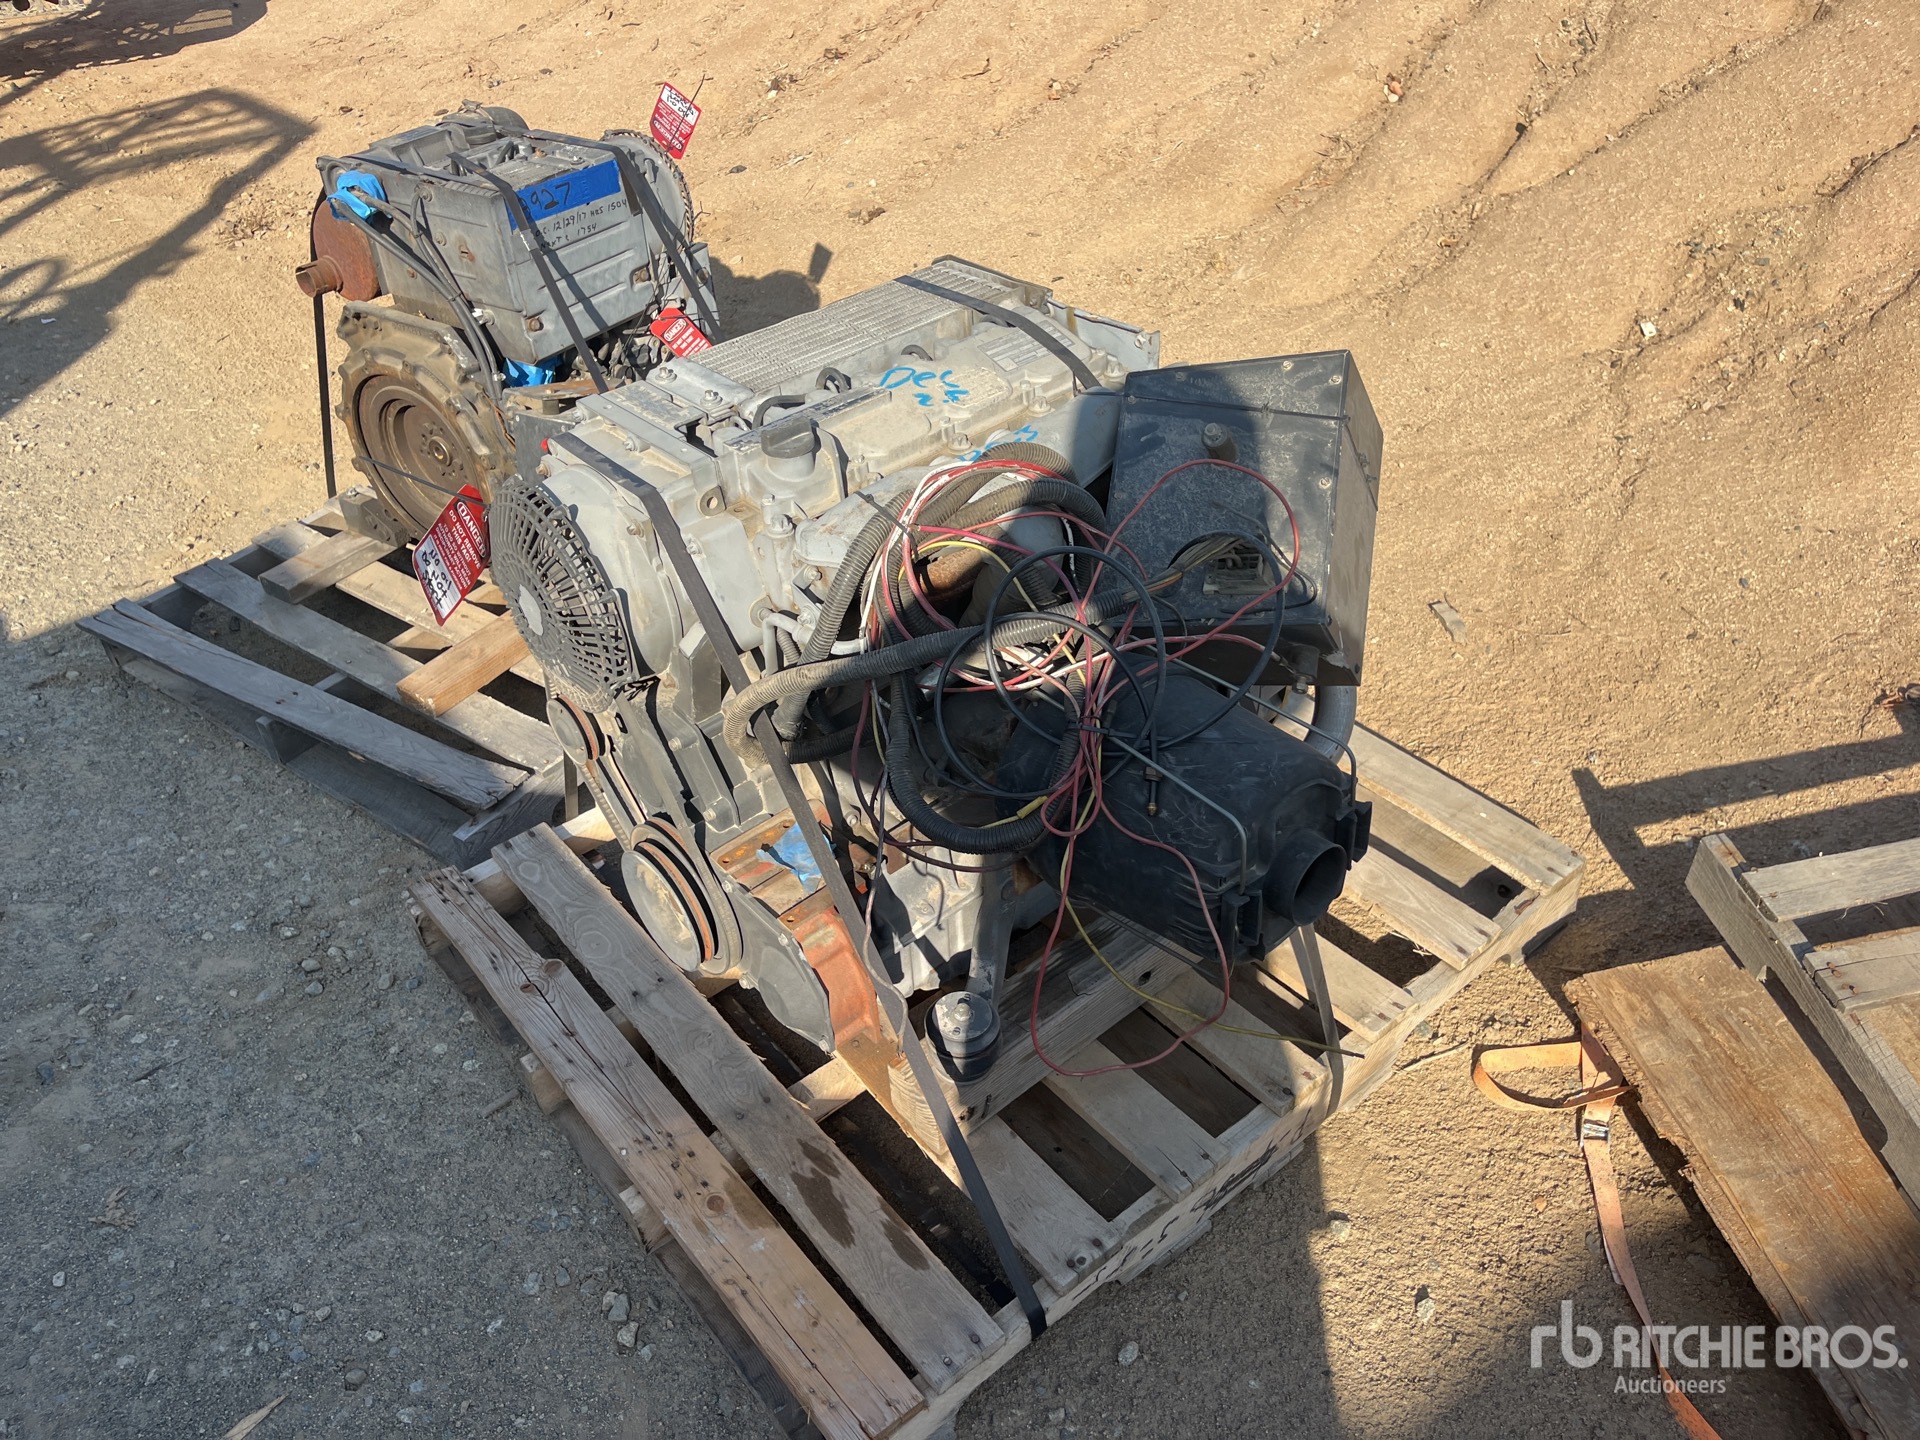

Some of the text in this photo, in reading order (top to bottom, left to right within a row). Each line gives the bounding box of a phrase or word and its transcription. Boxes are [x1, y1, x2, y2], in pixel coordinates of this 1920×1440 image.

[608, 198, 628, 212] 1504
[577, 223, 597, 236] 1754
[438, 523, 455, 554] AUTHORITY
[449, 510, 481, 569] DO NOT REMOVE
[452, 527, 471, 562] THIS TAG!
[459, 505, 486, 553] DANGER
[457, 551, 471, 576] WITHOUT
